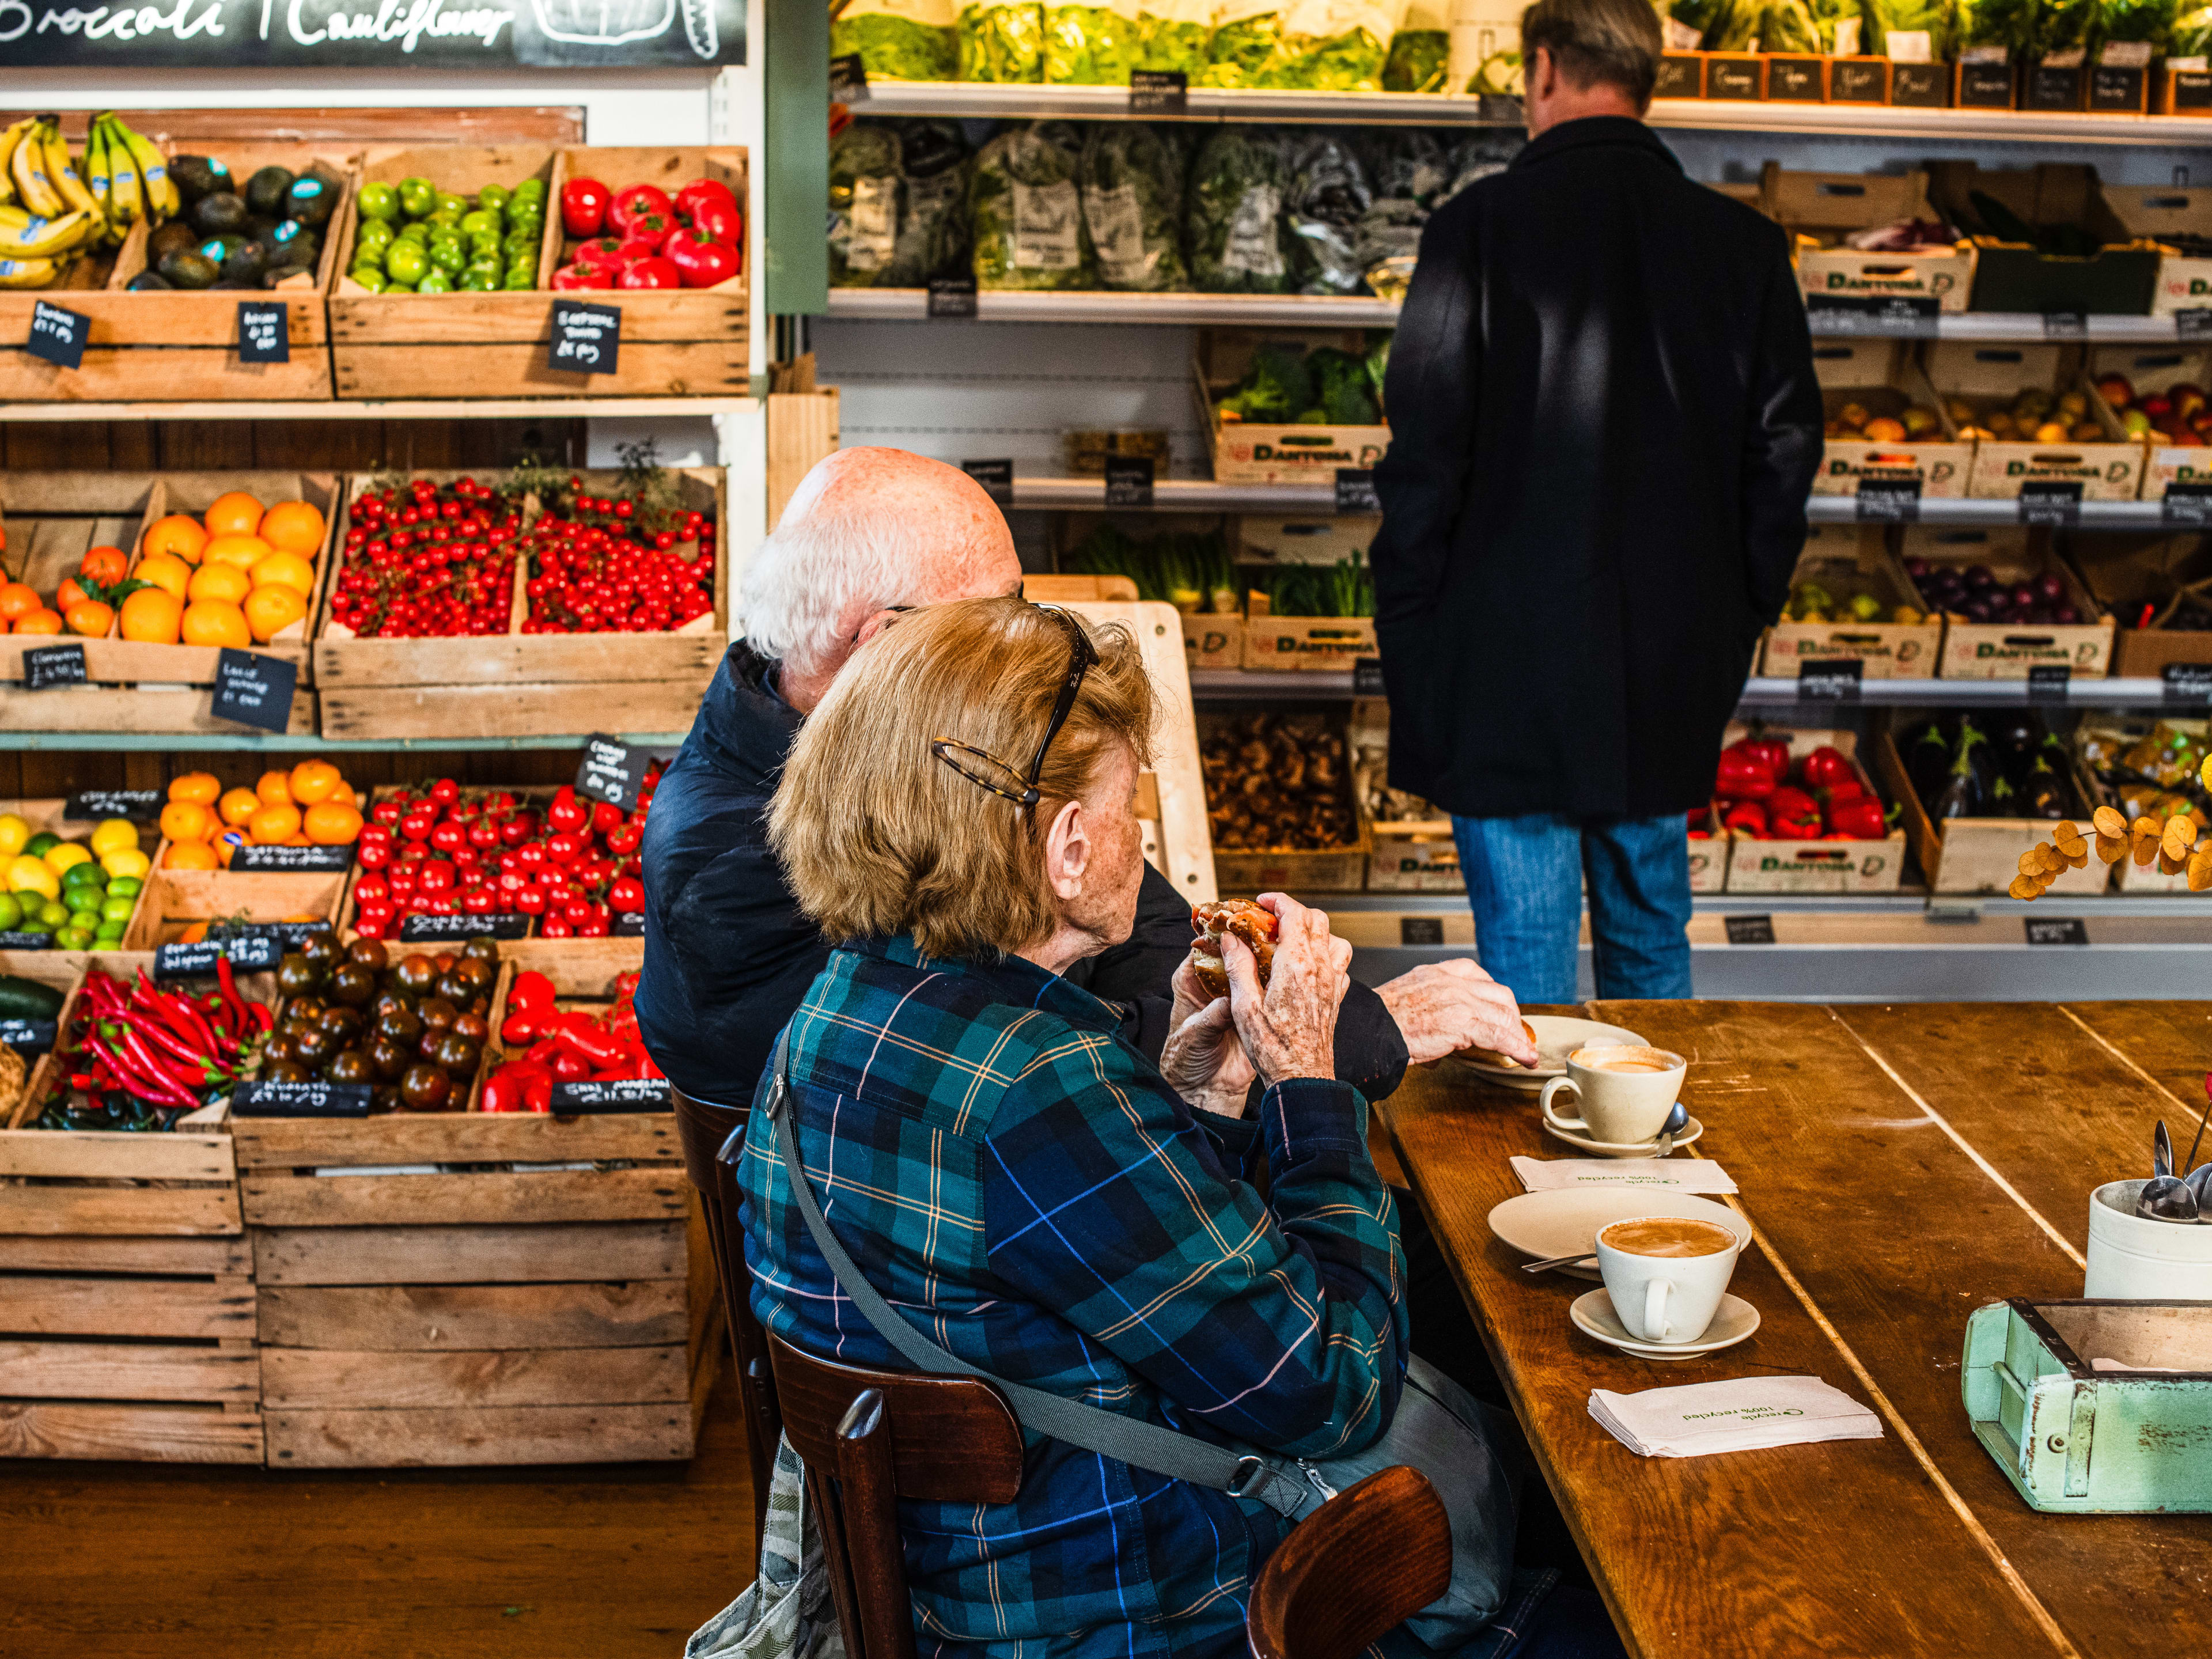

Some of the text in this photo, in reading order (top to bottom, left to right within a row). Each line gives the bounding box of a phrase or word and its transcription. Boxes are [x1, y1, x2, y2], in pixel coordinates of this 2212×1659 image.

[1681, 1406, 1774, 1421] 100% recycled
[1740, 1411, 1781, 1421] recycle
